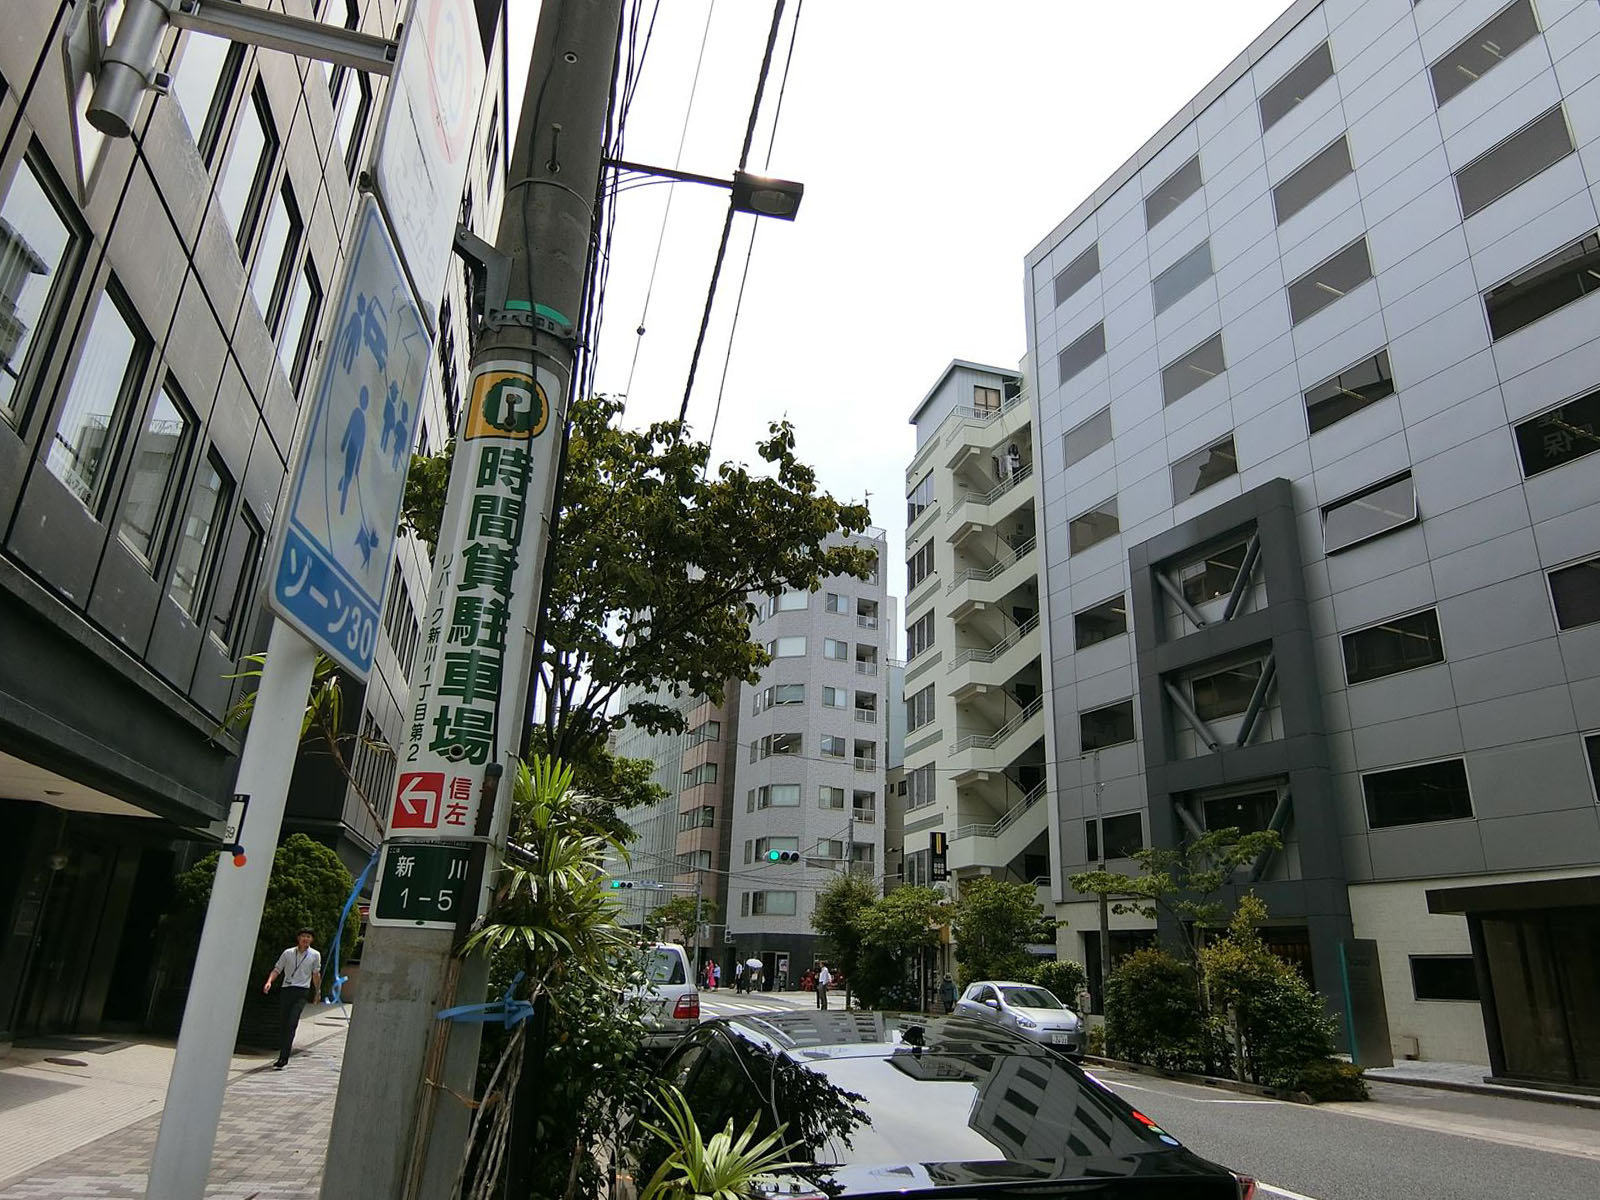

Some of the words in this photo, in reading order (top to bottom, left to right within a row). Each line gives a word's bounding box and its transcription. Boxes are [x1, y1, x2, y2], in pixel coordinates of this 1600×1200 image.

[497, 386, 532, 424] P
[284, 548, 373, 663] ゾーン30
[429, 446, 535, 766] 時間貸駐車場
[444, 776, 473, 827] 信左
